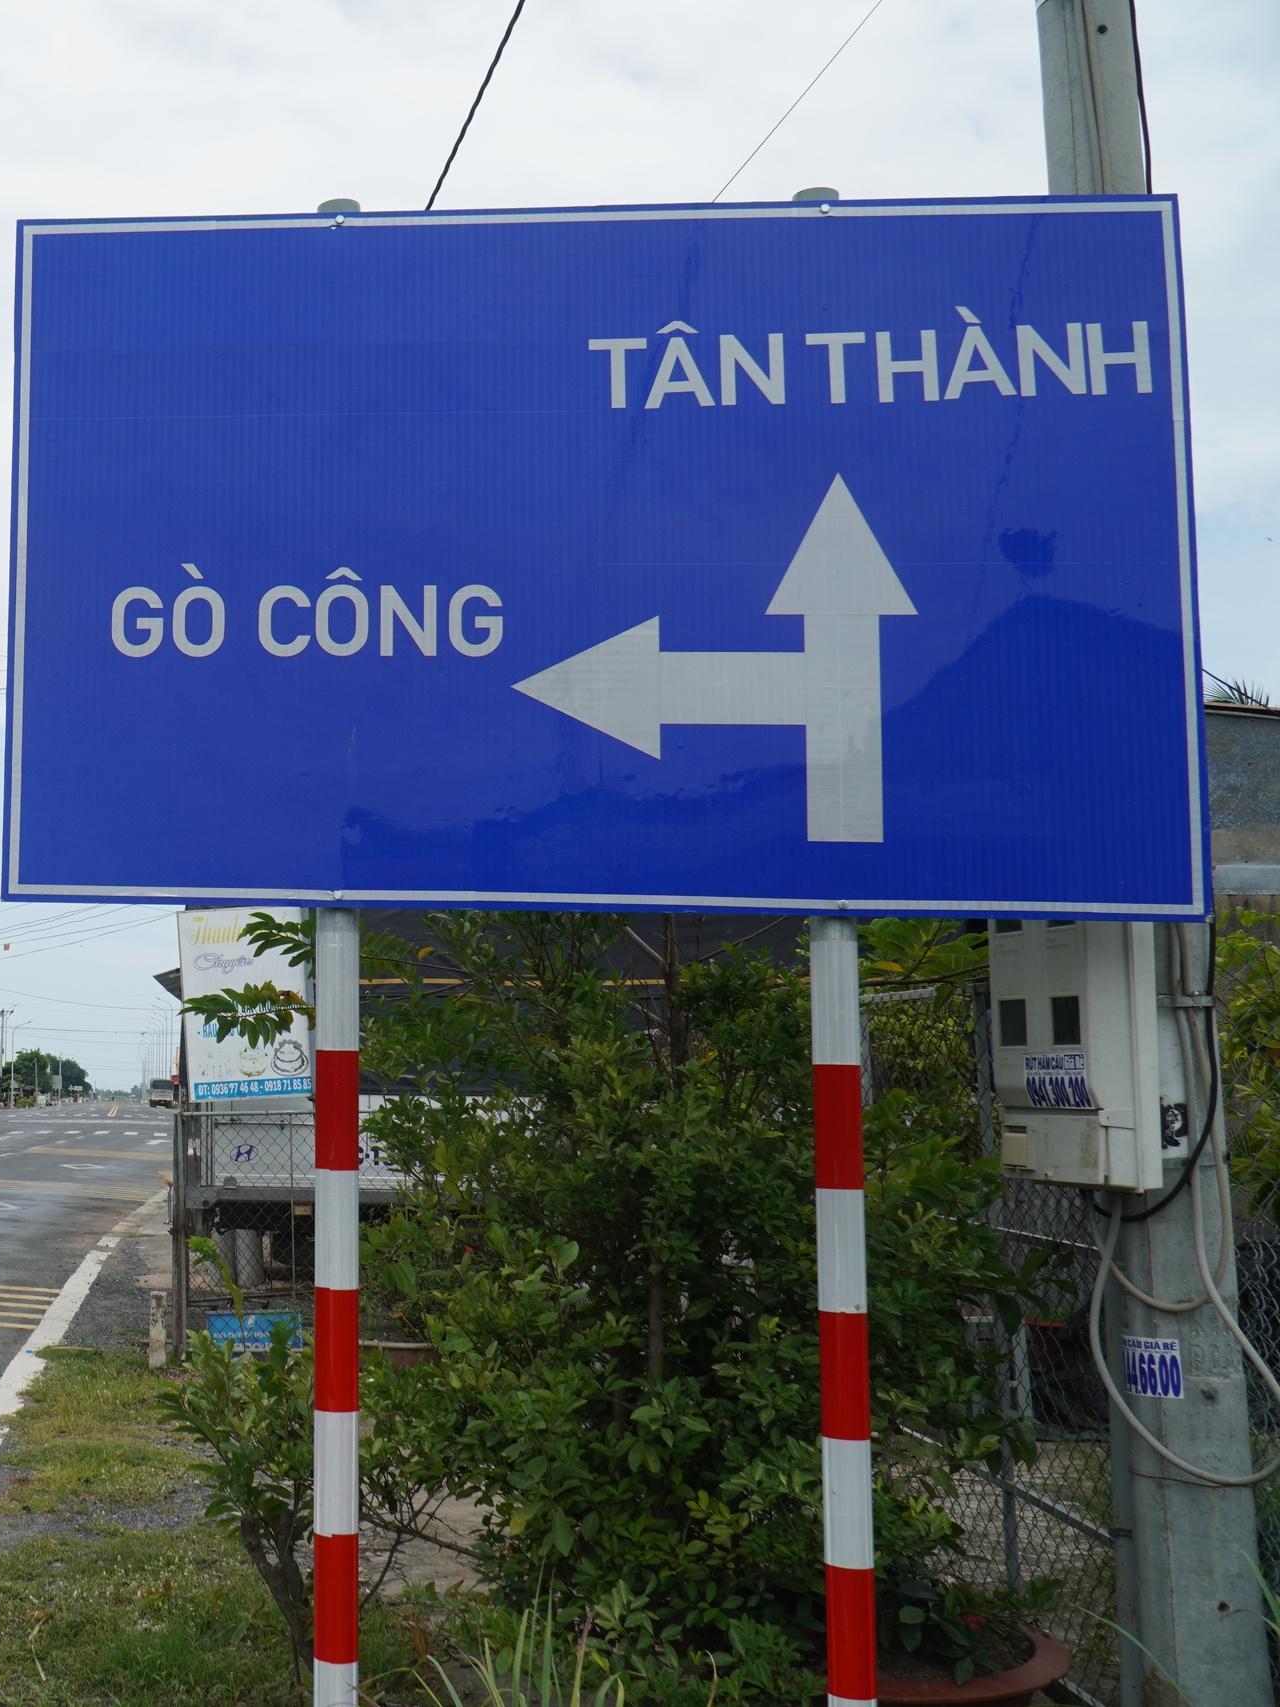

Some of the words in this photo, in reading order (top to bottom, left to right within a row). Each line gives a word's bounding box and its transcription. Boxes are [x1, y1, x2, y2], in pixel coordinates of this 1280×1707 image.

[588, 320, 786, 409] TÂN
[805, 305, 1153, 404] THÀNH
[111, 563, 225, 658] GÒ
[258, 566, 504, 658] CÔNG
[211, 1083, 229, 1095] 0936
[240, 1081, 248, 1093] 46
[264, 1080, 281, 1091] 0918
[283, 1079, 291, 1090] 71
[293, 1078, 301, 1090] 85
[303, 1078, 311, 1089] 85
